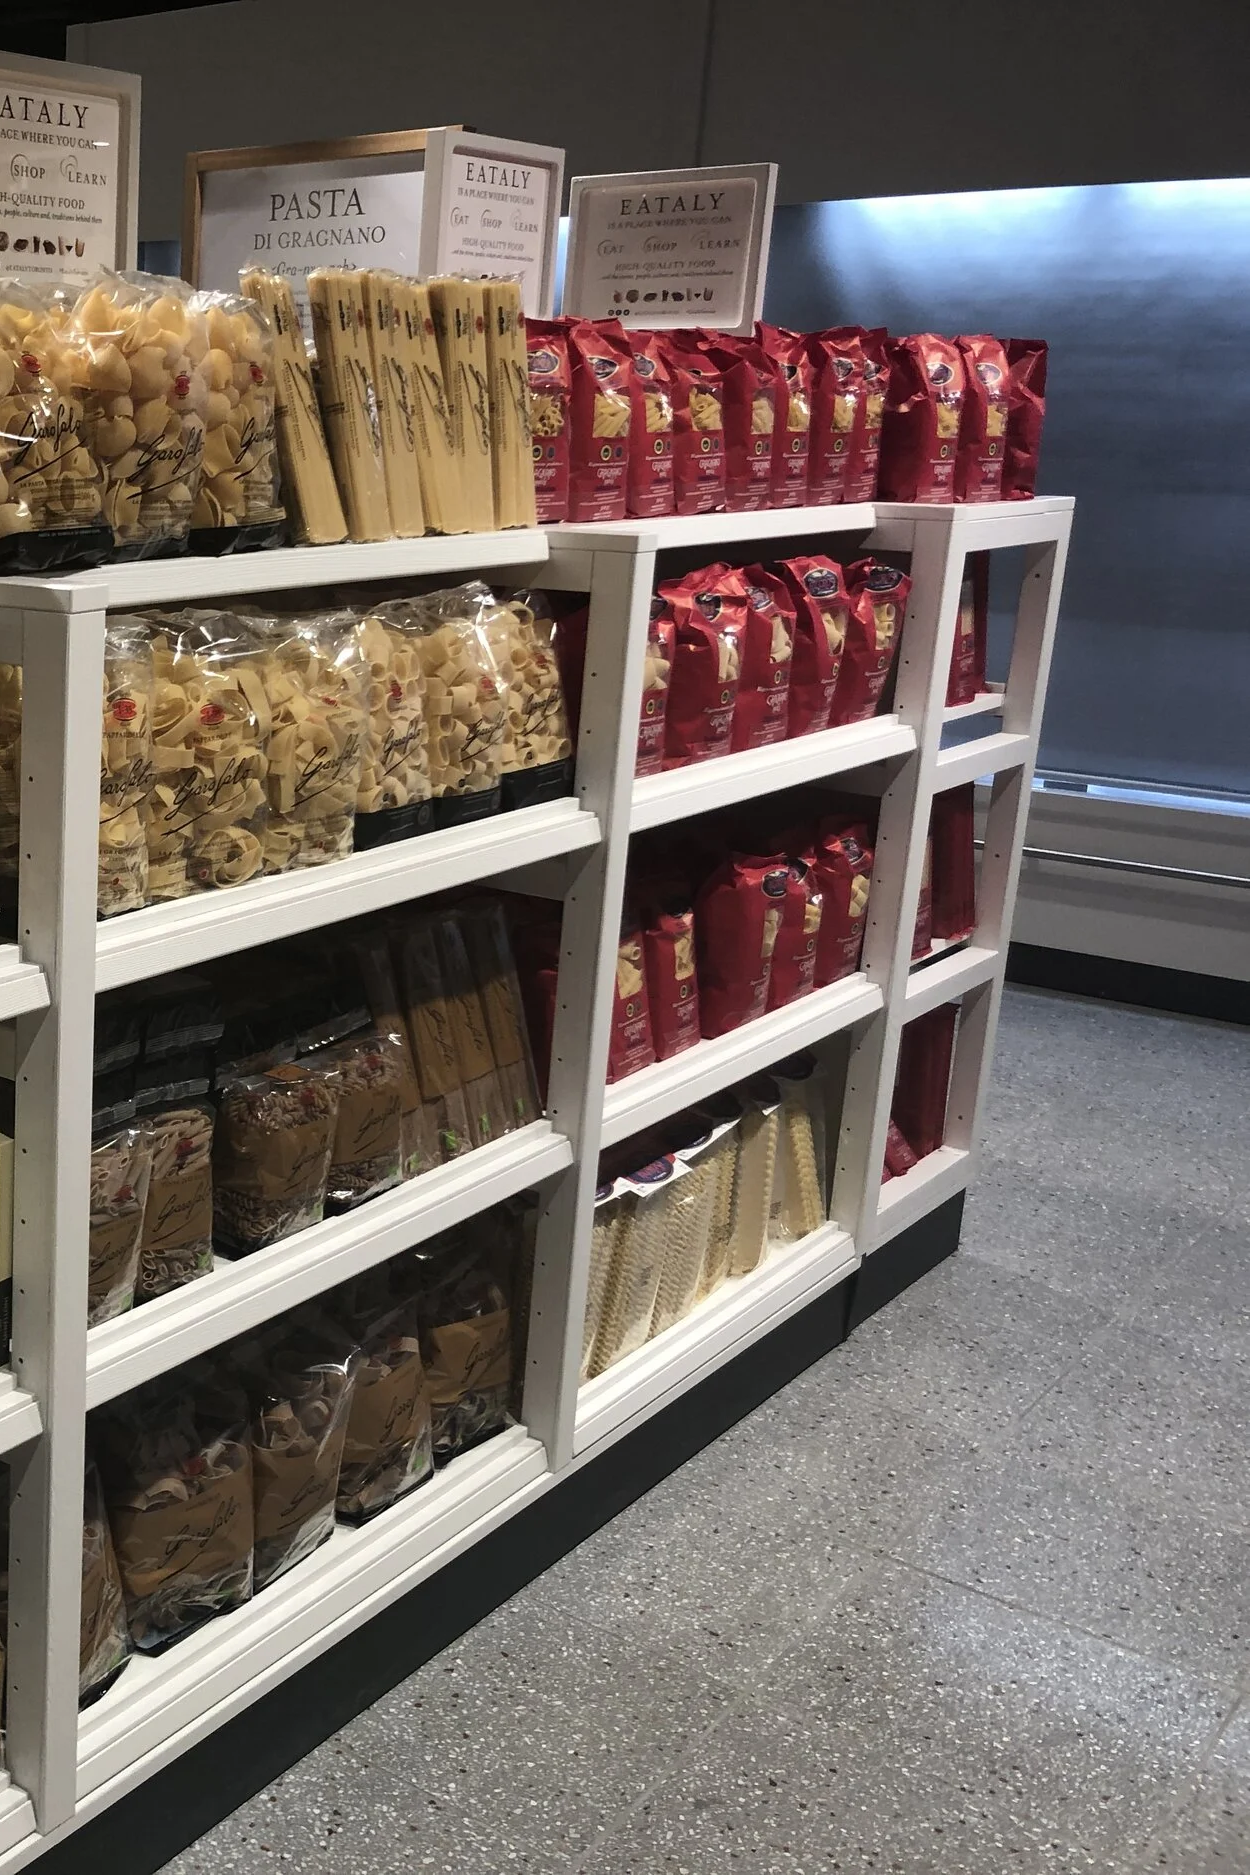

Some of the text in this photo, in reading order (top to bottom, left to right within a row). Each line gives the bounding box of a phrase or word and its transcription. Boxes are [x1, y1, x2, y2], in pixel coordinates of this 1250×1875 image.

[20, 130, 55, 146] WHERE
[56, 135, 77, 149] YOU
[78, 137, 99, 151] CAN
[13, 163, 46, 180] SHOP
[68, 170, 108, 187] LEARN
[466, 162, 532, 190] EATALY
[58, 196, 86, 210] FOOD
[269, 187, 366, 222] PASTA
[619, 192, 725, 217] EATALY
[454, 215, 538, 233] EAT SHOP LEARN
[253, 224, 387, 251] DI GRAGNANO
[603, 244, 625, 255] EAT
[699, 238, 741, 250] LEARN
[13, 403, 82, 466] Garofalo
[164, 757, 253, 821] Garofalo
[156, 1495, 242, 1570] Garofalo
